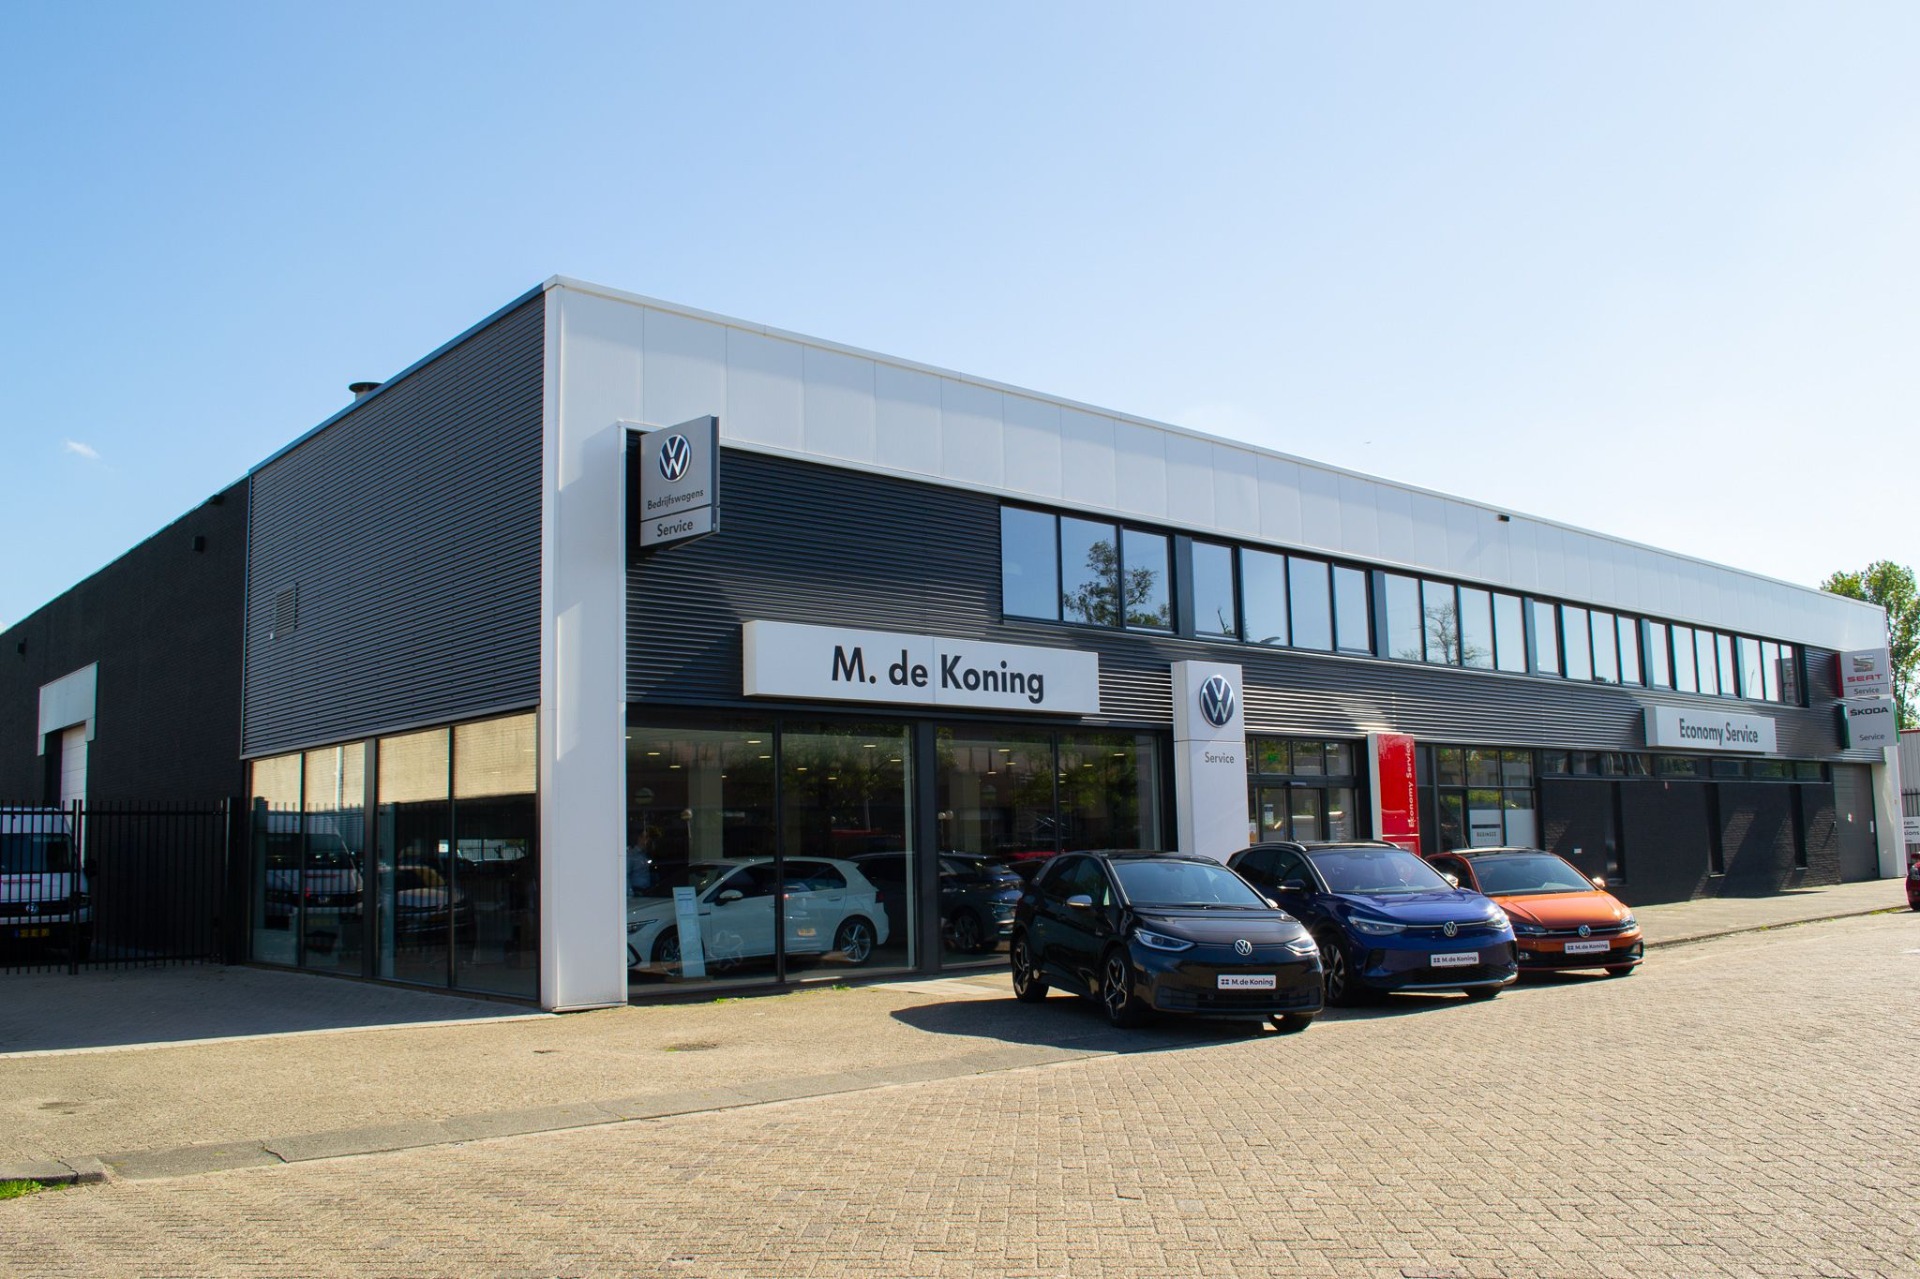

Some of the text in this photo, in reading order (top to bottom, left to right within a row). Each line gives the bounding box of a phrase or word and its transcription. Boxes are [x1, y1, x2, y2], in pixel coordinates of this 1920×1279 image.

[647, 489, 704, 510] Bedrijfswagens
[656, 520, 694, 538] Service
[831, 645, 1044, 704] M. de Koning
[1846, 673, 1883, 683] SEAT
[1853, 687, 1880, 695] Service
[1679, 717, 1758, 746] Economy Service
[1860, 732, 1886, 741] Service
[1204, 751, 1235, 764] Service
